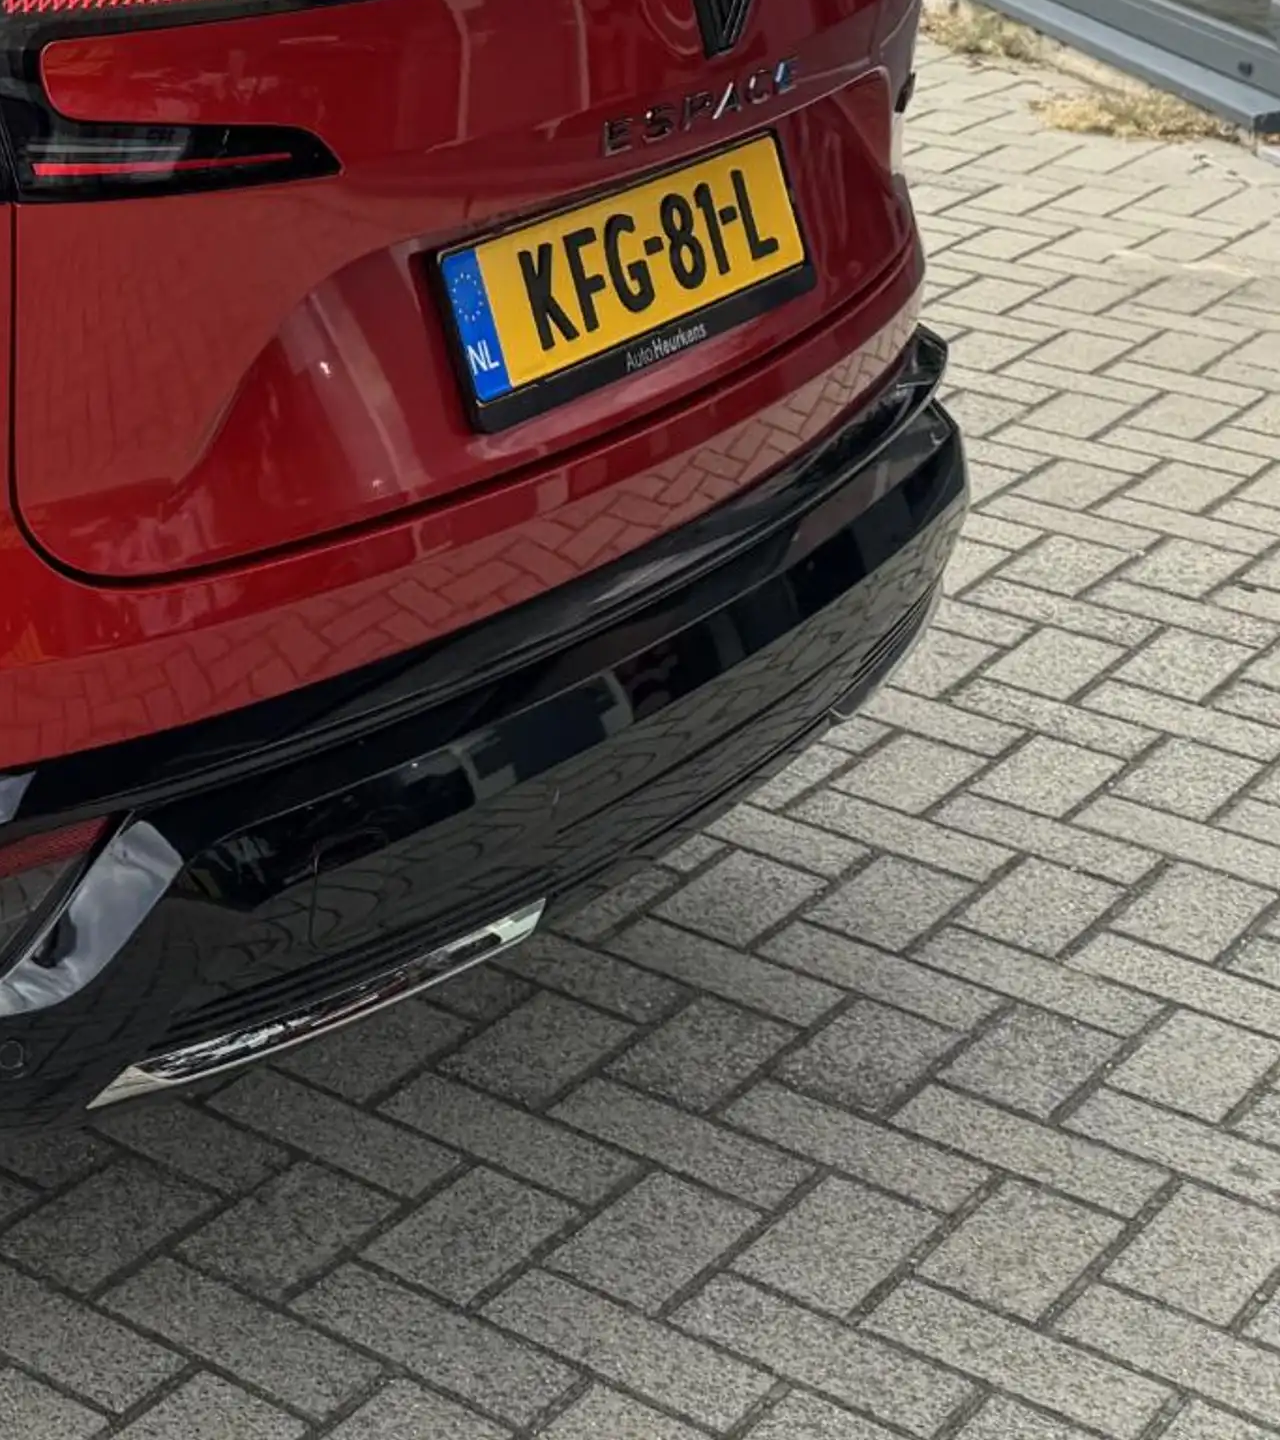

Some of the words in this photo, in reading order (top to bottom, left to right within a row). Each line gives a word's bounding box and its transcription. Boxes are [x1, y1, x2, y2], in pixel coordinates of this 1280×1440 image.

[603, 56, 800, 158] ESPACE
[517, 168, 779, 352] KFG-81-L
[466, 342, 500, 376] NL
